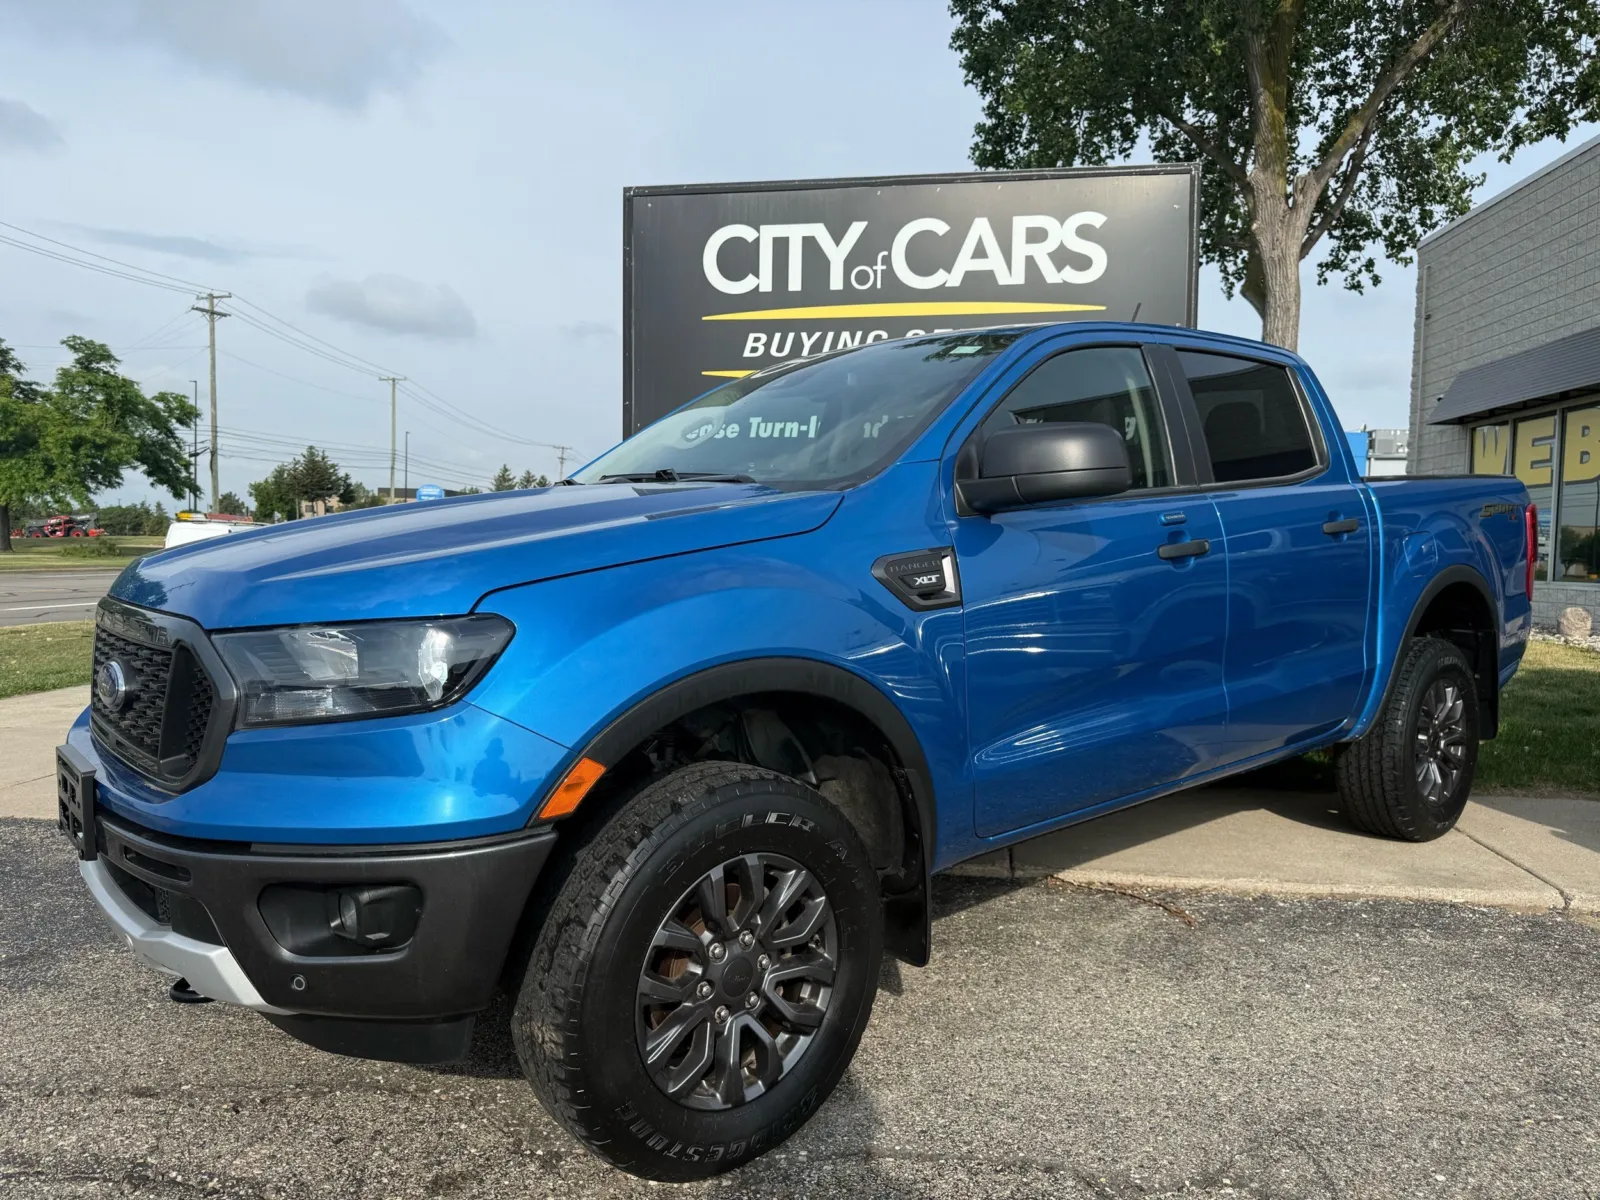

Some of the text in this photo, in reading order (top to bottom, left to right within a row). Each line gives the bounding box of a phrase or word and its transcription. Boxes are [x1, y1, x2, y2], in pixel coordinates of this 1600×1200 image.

[702, 210, 1109, 295] CITY of CARS
[749, 415, 821, 439] Turn-I
[889, 560, 941, 573] RANGER
[913, 574, 940, 586] XLT
